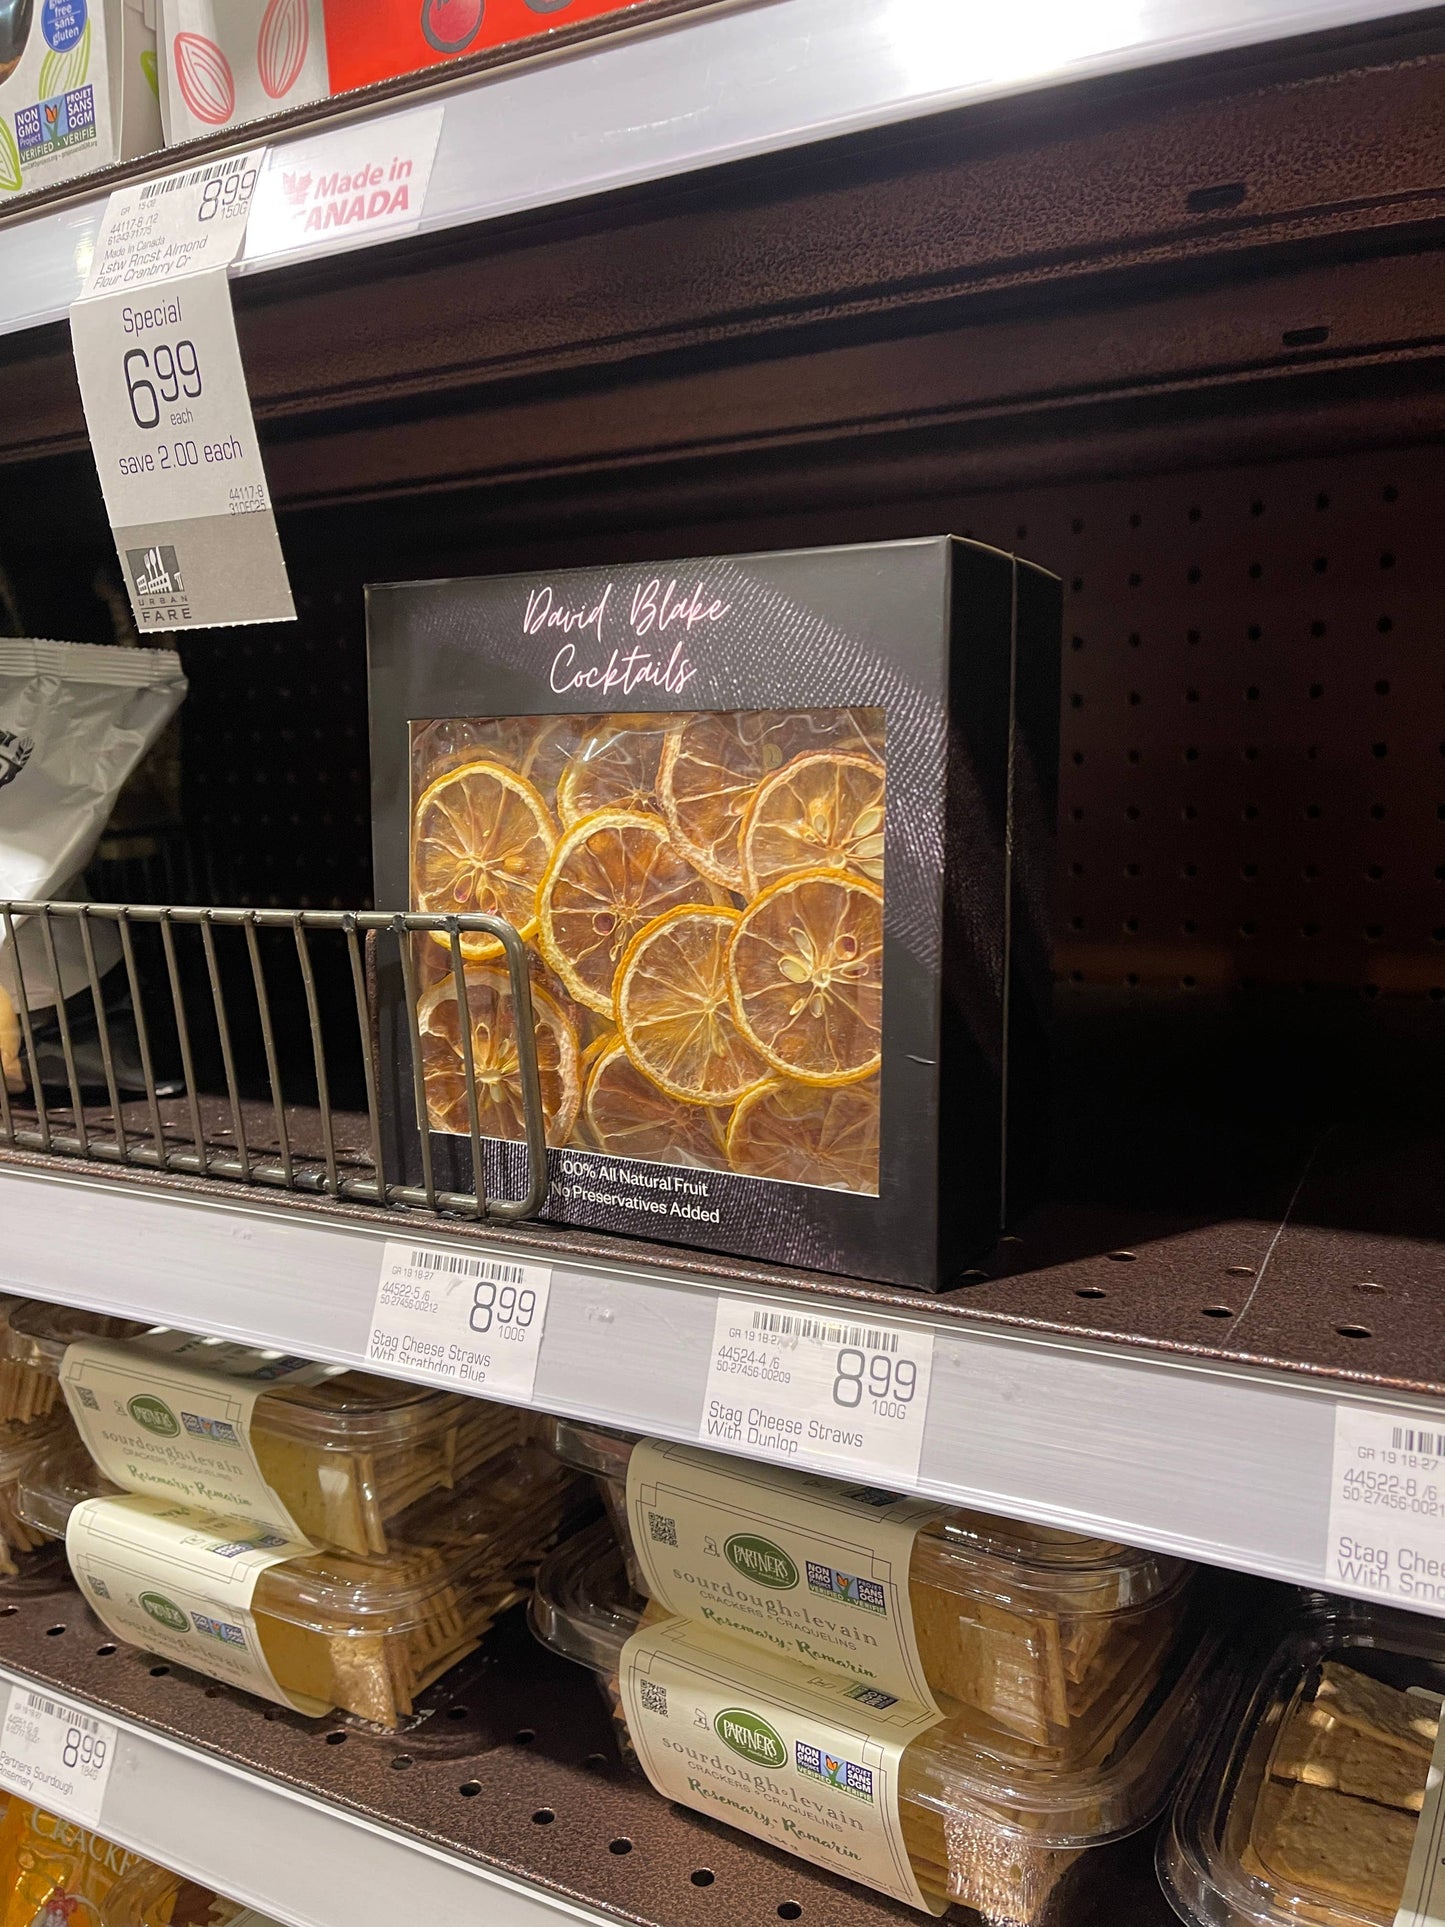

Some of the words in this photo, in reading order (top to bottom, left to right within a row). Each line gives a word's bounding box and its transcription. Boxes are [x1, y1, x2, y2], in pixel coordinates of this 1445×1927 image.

[55, 4, 72, 17] free
[54, 16, 75, 30] sans
[53, 26, 79, 46] gluten
[66, 87, 92, 104] PROJET
[68, 97, 92, 116] SANS
[17, 108, 38, 126] NON
[69, 110, 93, 128] OGM
[18, 121, 40, 138] GMO
[21, 142, 54, 161] VERIFIED
[314, 163, 384, 200] Made
[388, 156, 413, 181] in
[220, 201, 249, 220] 150G
[292, 184, 409, 233] ANADA
[136, 235, 165, 251] Canada
[163, 235, 209, 258] Almond
[93, 274, 122, 290] Flour
[176, 254, 192, 269] Cr
[122, 298, 182, 337] Special
[169, 408, 194, 427] each
[119, 450, 155, 476] save
[157, 440, 199, 471] 2.00
[203, 434, 243, 465] each
[229, 484, 264, 499] 44117-8
[138, 595, 188, 606] URBAN
[523, 583, 613, 642] David
[630, 579, 732, 636] Blake
[142, 608, 192, 623] FARE
[550, 641, 697, 695] Cocktails
[599, 1166, 617, 1182] All
[619, 1169, 672, 1191] Natural
[674, 1177, 710, 1197] Fruit
[551, 1180, 570, 1198] No
[573, 1185, 667, 1215] Preservatives
[669, 1201, 720, 1224] Added
[392, 1266, 402, 1275] GR
[382, 1281, 421, 1300] 44522-5
[498, 1324, 526, 1342] 100G
[729, 1327, 742, 1338] GR
[745, 1330, 755, 1341] 19
[372, 1329, 399, 1351] Stag
[402, 1335, 445, 1357] Cheese
[449, 1344, 491, 1367] Straws
[718, 1345, 766, 1367] 44524-4
[769, 1356, 780, 1370] /6
[459, 1363, 486, 1383] Blue
[716, 1360, 791, 1384] 50-27456-00209
[871, 1399, 907, 1420] 100G
[709, 1400, 743, 1426] Stag
[748, 1408, 803, 1435] Cheese
[808, 1420, 864, 1448] Straws
[707, 1418, 742, 1441] With
[747, 1427, 798, 1457] Dunlop
[1357, 1446, 1375, 1461] GR
[1380, 1450, 1396, 1464] 19
[1401, 1454, 1439, 1471] 18-27
[1344, 1468, 1417, 1497] 44522-8
[1423, 1486, 1438, 1501] /6
[733, 1544, 789, 1580] PARTNERS
[1339, 1536, 1388, 1571] Stag
[807, 1563, 830, 1576] NON
[808, 1571, 831, 1584] GMO
[1337, 1559, 1390, 1590] With
[809, 1584, 843, 1601] VERIFIED
[858, 1585, 883, 1599] SANS
[859, 1592, 884, 1607] OGM
[673, 1568, 793, 1618] sourdough
[802, 1607, 879, 1648] levain
[699, 1590, 763, 1618] CRACKERS
[776, 1617, 857, 1651] CRAQUELINS
[796, 1638, 877, 1679] Romarin
[723, 1719, 777, 1758] PARTNERS
[797, 1743, 820, 1759] NON
[797, 1752, 820, 1766] GMO
[798, 1766, 832, 1785] VERIFIED
[847, 1763, 871, 1777] PROJET
[847, 1770, 871, 1786] SANS
[662, 1737, 781, 1796] sourdough
[790, 1786, 865, 1832] levain
[847, 1779, 871, 1794] OGM
[687, 1760, 750, 1793] CRACKERS
[763, 1792, 844, 1832] CRAQUELINS
[781, 1817, 862, 1861] Romarin
